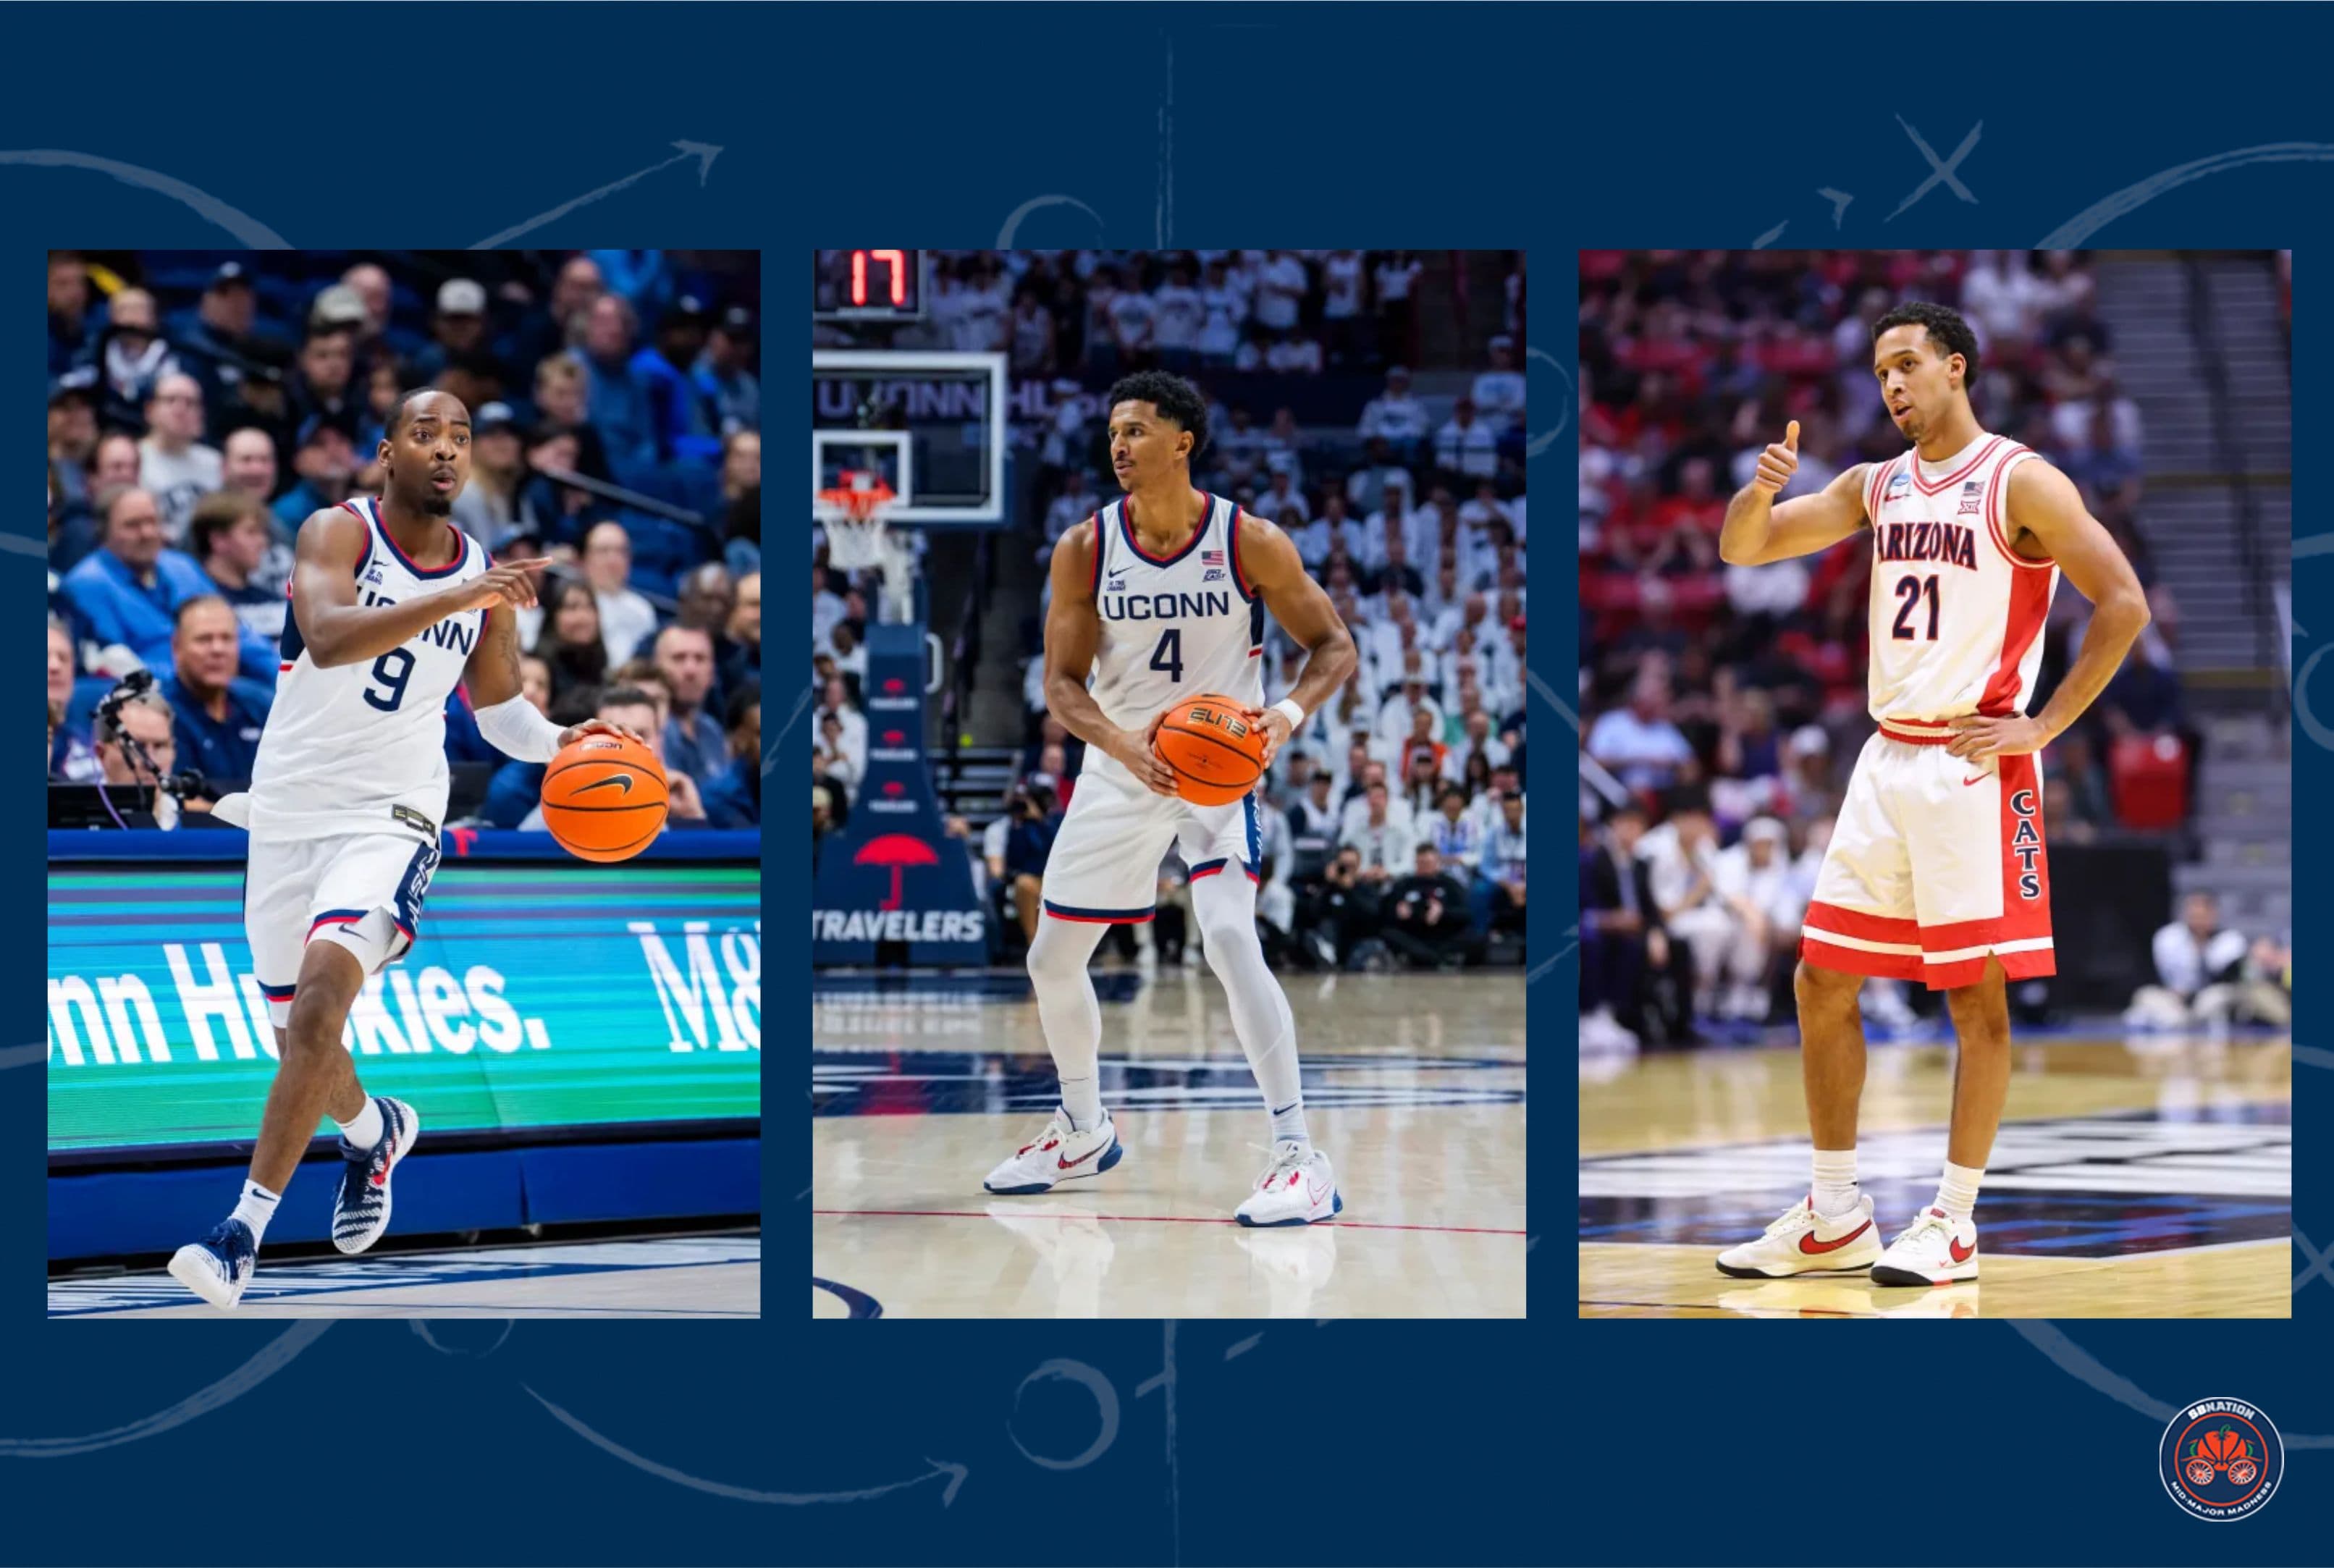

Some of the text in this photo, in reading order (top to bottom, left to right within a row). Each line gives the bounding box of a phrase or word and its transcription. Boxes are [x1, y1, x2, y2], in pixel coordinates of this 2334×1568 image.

[851, 250, 904, 305] 17
[1104, 591, 1229, 620] UCONN
[1892, 574, 1939, 640] 21
[363, 646, 416, 712] 9
[1150, 629, 1183, 682] 4
[1189, 707, 1247, 739] ELITE
[2010, 790, 2040, 900] CATS
[813, 910, 985, 941] TRAVELERS
[48, 974, 172, 1065] nn
[162, 943, 552, 1061] Hukies.
